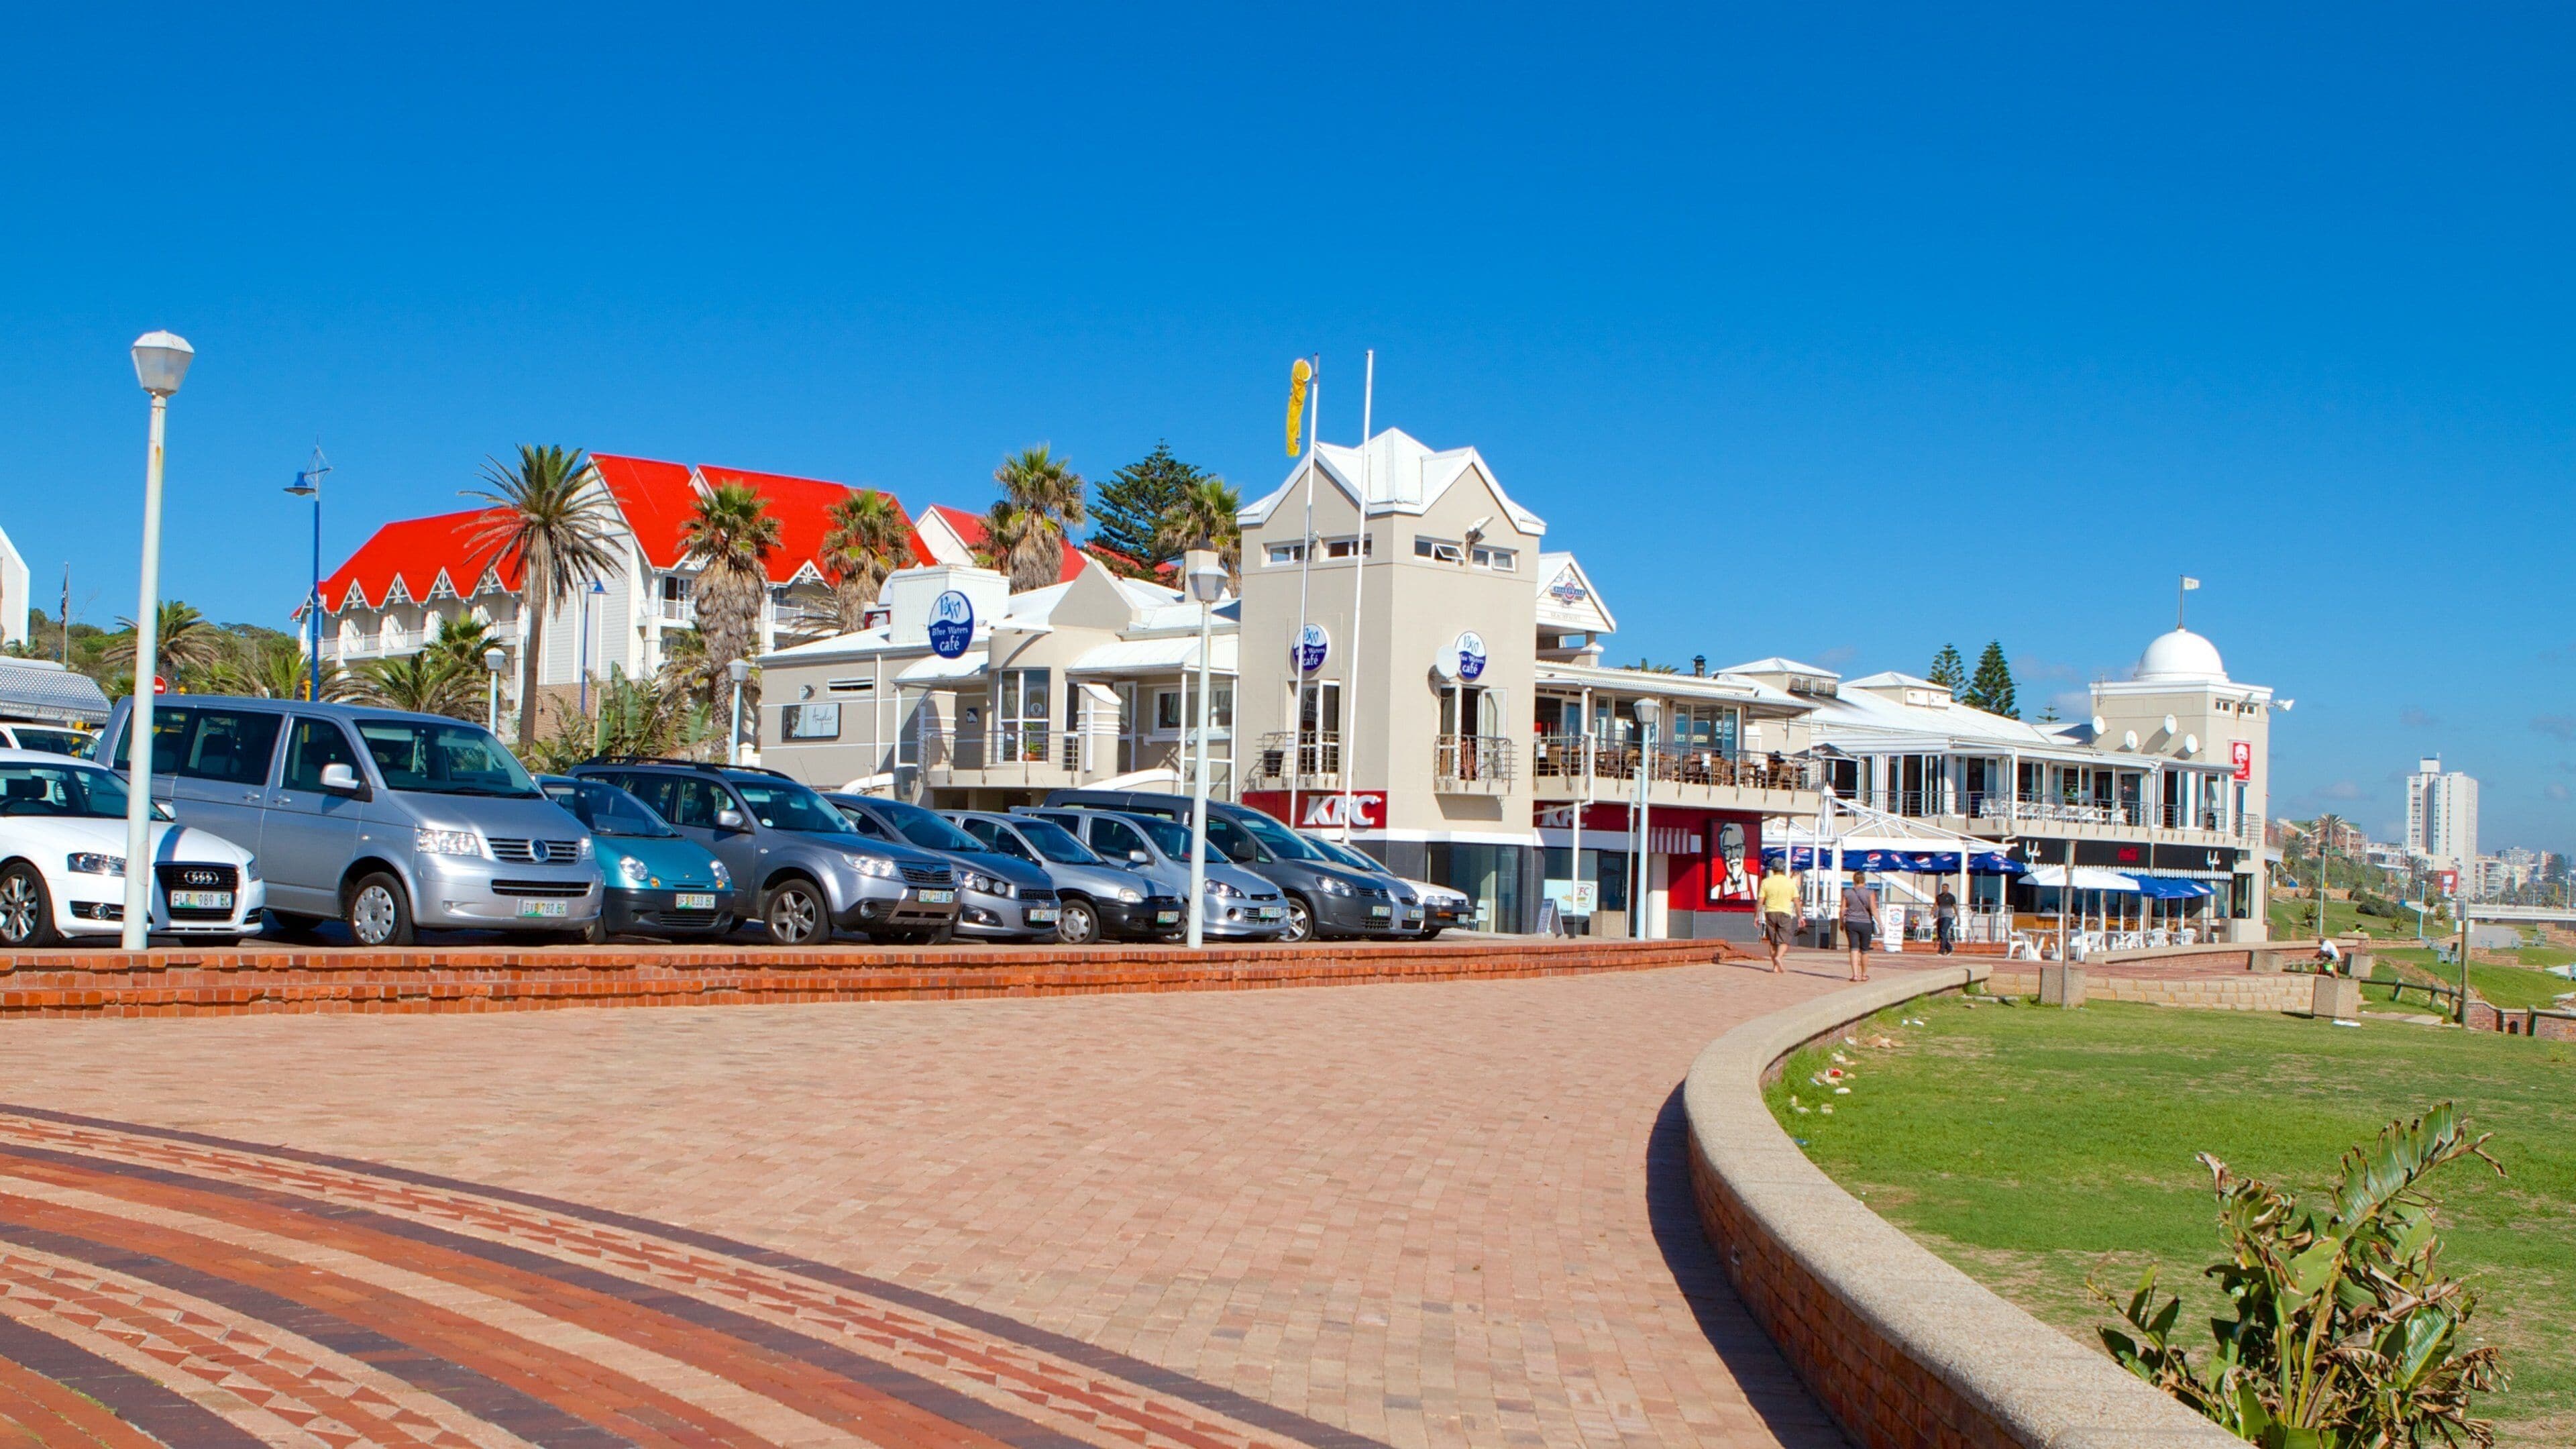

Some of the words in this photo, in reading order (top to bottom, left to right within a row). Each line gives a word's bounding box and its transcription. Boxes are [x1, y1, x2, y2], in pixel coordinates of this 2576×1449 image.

[932, 627, 946, 637] Blue
[947, 626, 968, 635] Waters
[939, 635, 960, 651] café
[1303, 654, 1319, 666] café
[1468, 655, 1485, 664] Waters
[1462, 661, 1479, 675] café
[1302, 794, 1382, 826] KFC
[1578, 887, 1590, 896] FC
[174, 893, 191, 905] FLR
[199, 894, 213, 906] 989
[220, 894, 229, 906] EC
